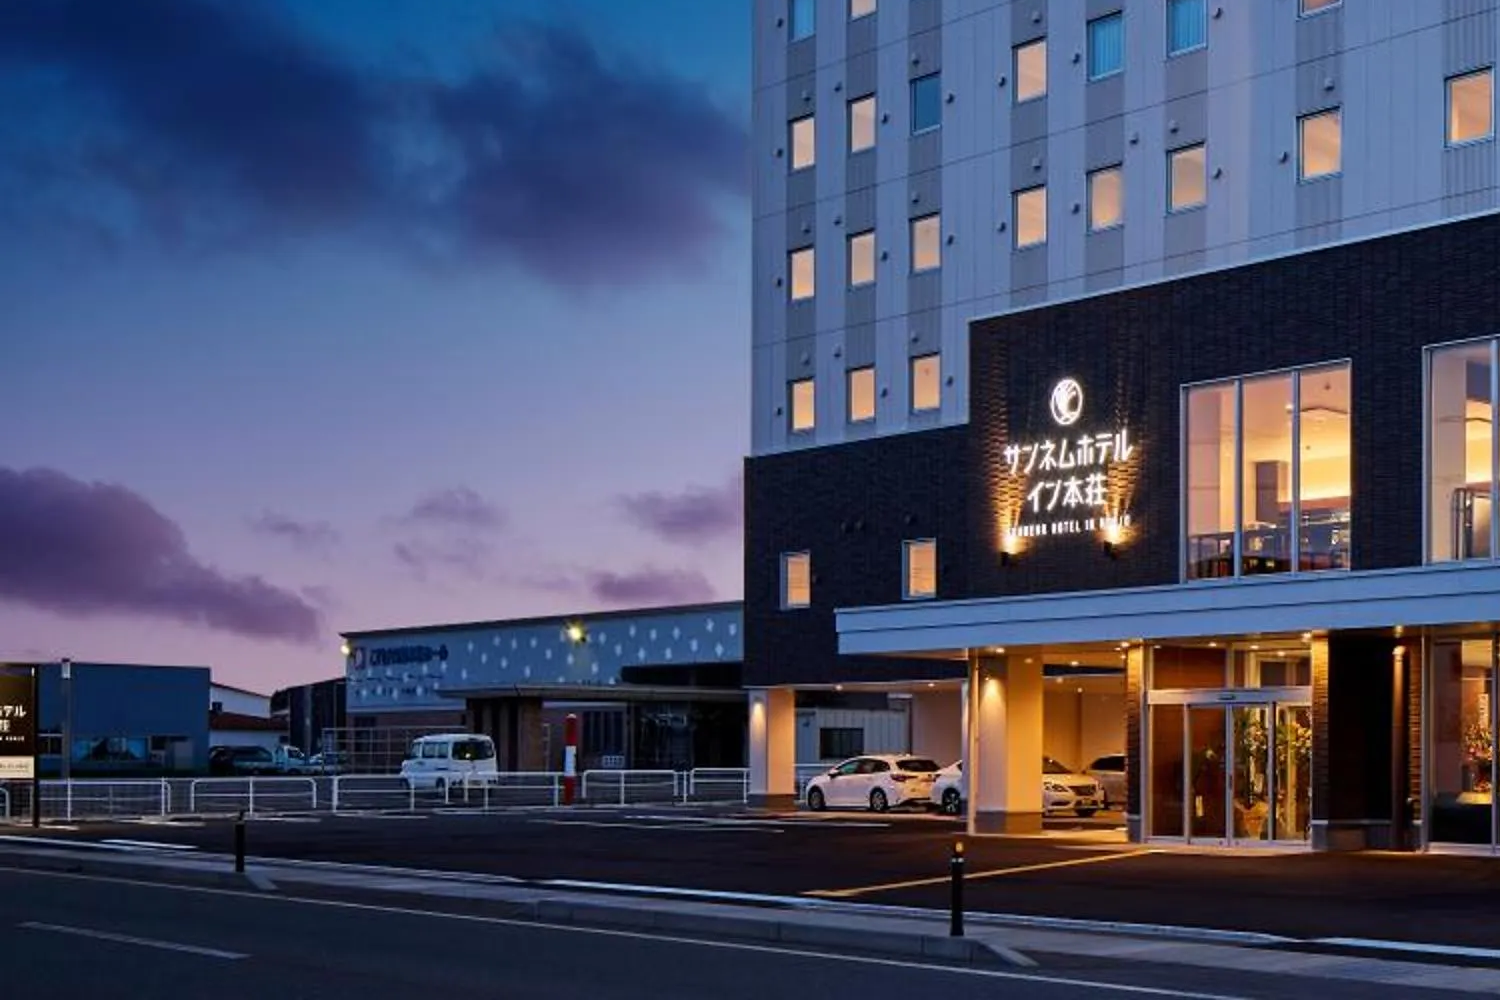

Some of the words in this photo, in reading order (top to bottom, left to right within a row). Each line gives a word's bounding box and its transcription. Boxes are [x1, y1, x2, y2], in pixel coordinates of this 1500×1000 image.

[1004, 428, 1133, 475] サンネムホテル
[1027, 473, 1108, 513] イン本荘
[0, 704, 27, 718] テル
